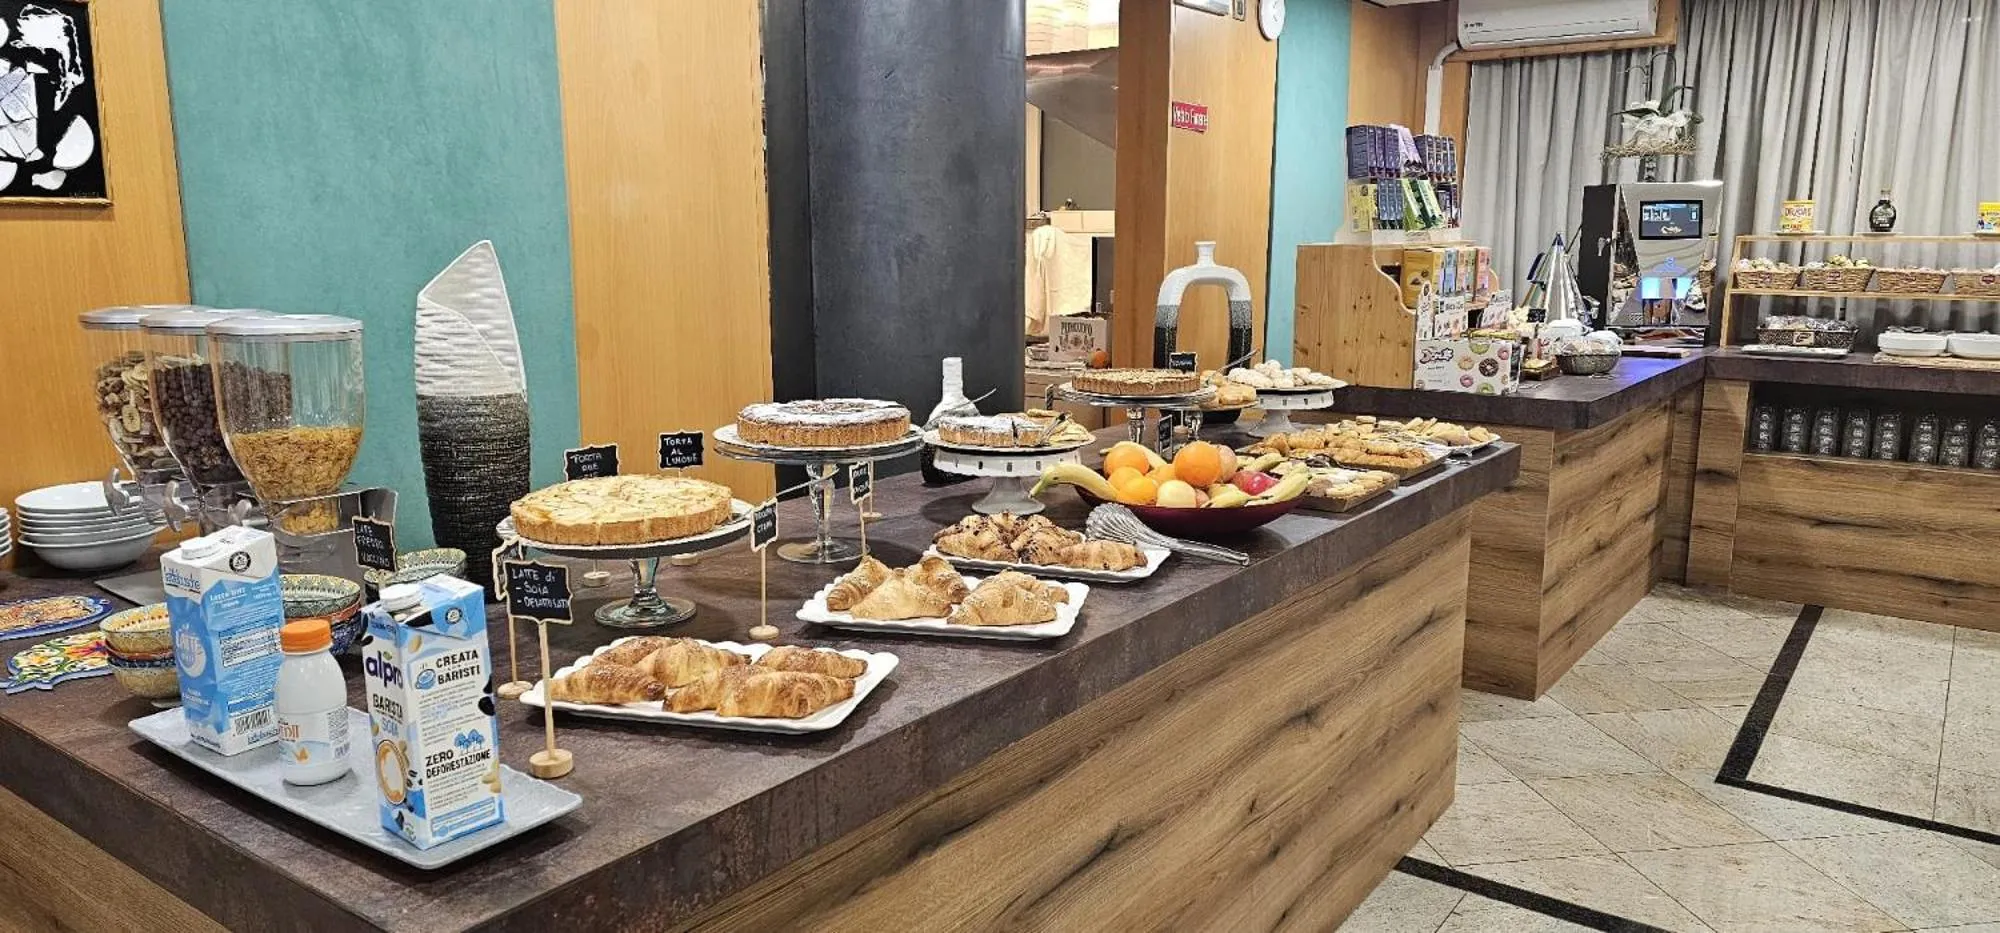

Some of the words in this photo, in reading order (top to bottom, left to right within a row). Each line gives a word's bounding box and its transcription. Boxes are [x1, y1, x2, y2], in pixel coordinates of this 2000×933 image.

[663, 436, 693, 446] TORTA
[671, 448, 684, 456] AL
[511, 568, 540, 581] LATTE
[436, 649, 479, 668] CREATA
[365, 651, 404, 689] alpro
[438, 665, 480, 685] BARISTI
[425, 749, 454, 767] ZERO
[426, 749, 491, 778] DEFORESTAZIONE
